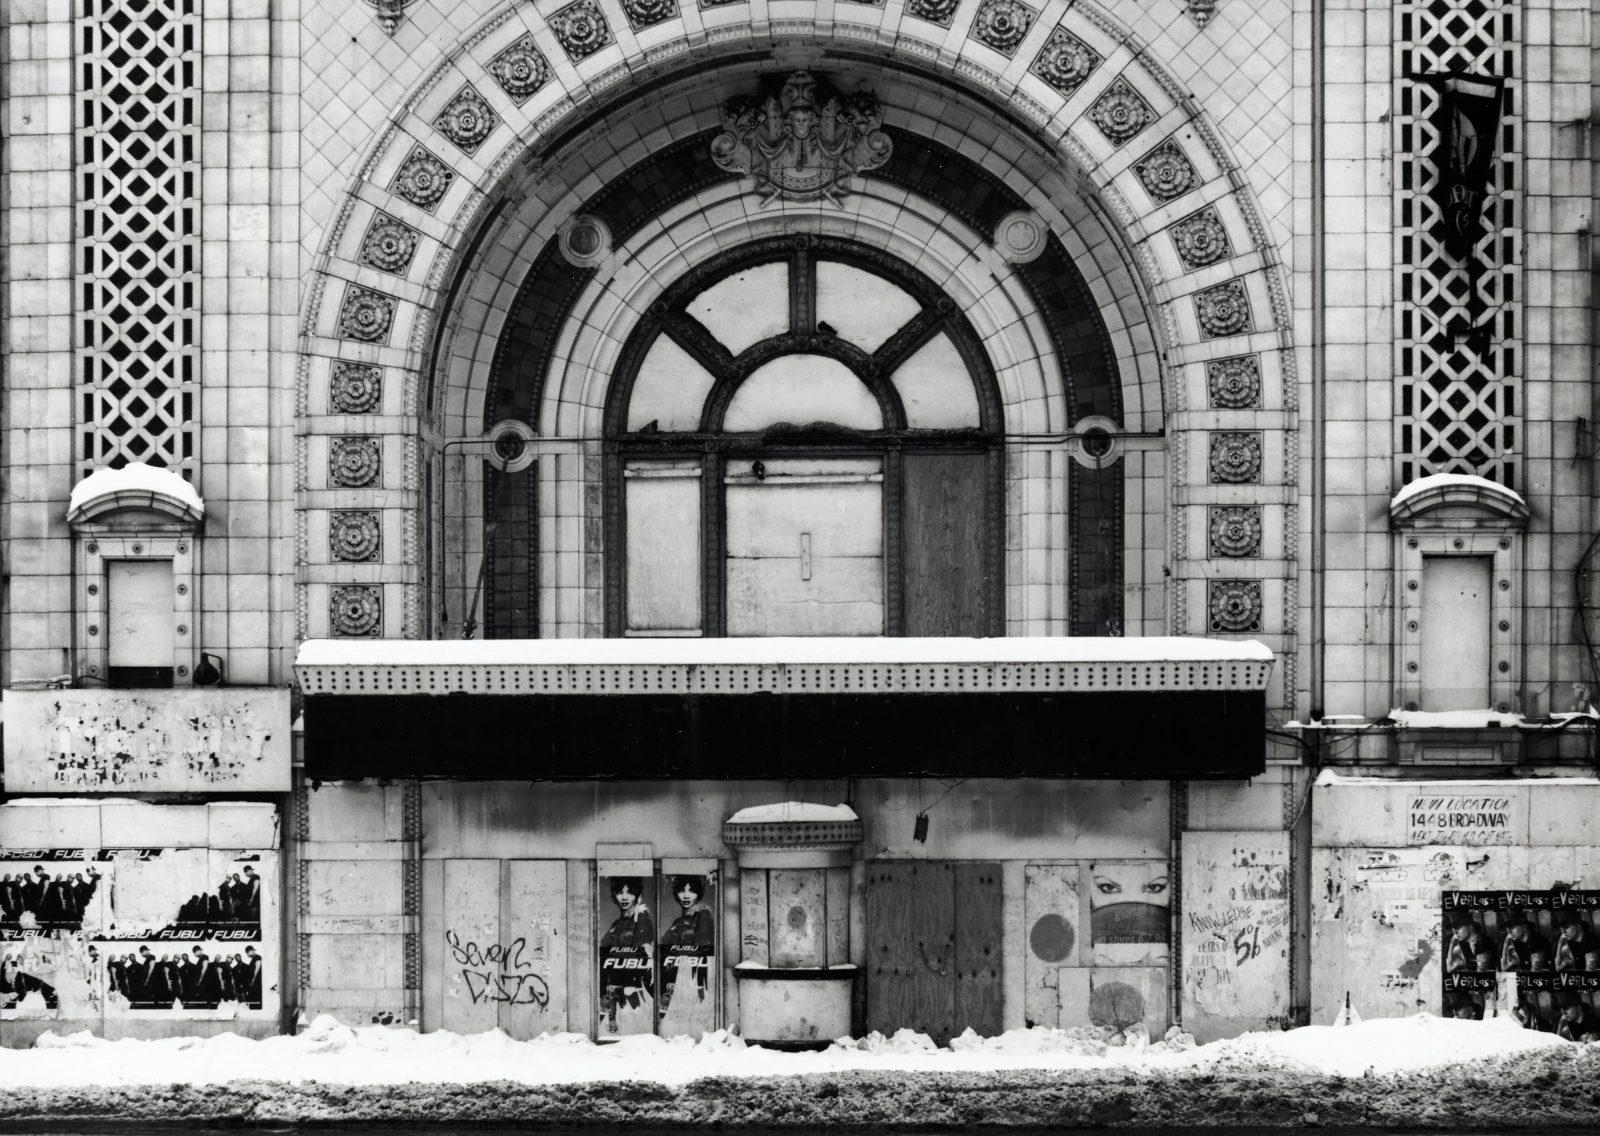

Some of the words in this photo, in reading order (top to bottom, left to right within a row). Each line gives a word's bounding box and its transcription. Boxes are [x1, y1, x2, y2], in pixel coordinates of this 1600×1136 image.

[1446, 798, 1510, 811] LOCATION
[1410, 812, 1448, 828] 1448
[1449, 812, 1511, 828] BROADWAY
[54, 849, 85, 859] FUB
[159, 930, 205, 939] FUBU
[212, 930, 257, 939] FUBU
[669, 944, 699, 952] FUBU
[603, 957, 651, 969] FUBU
